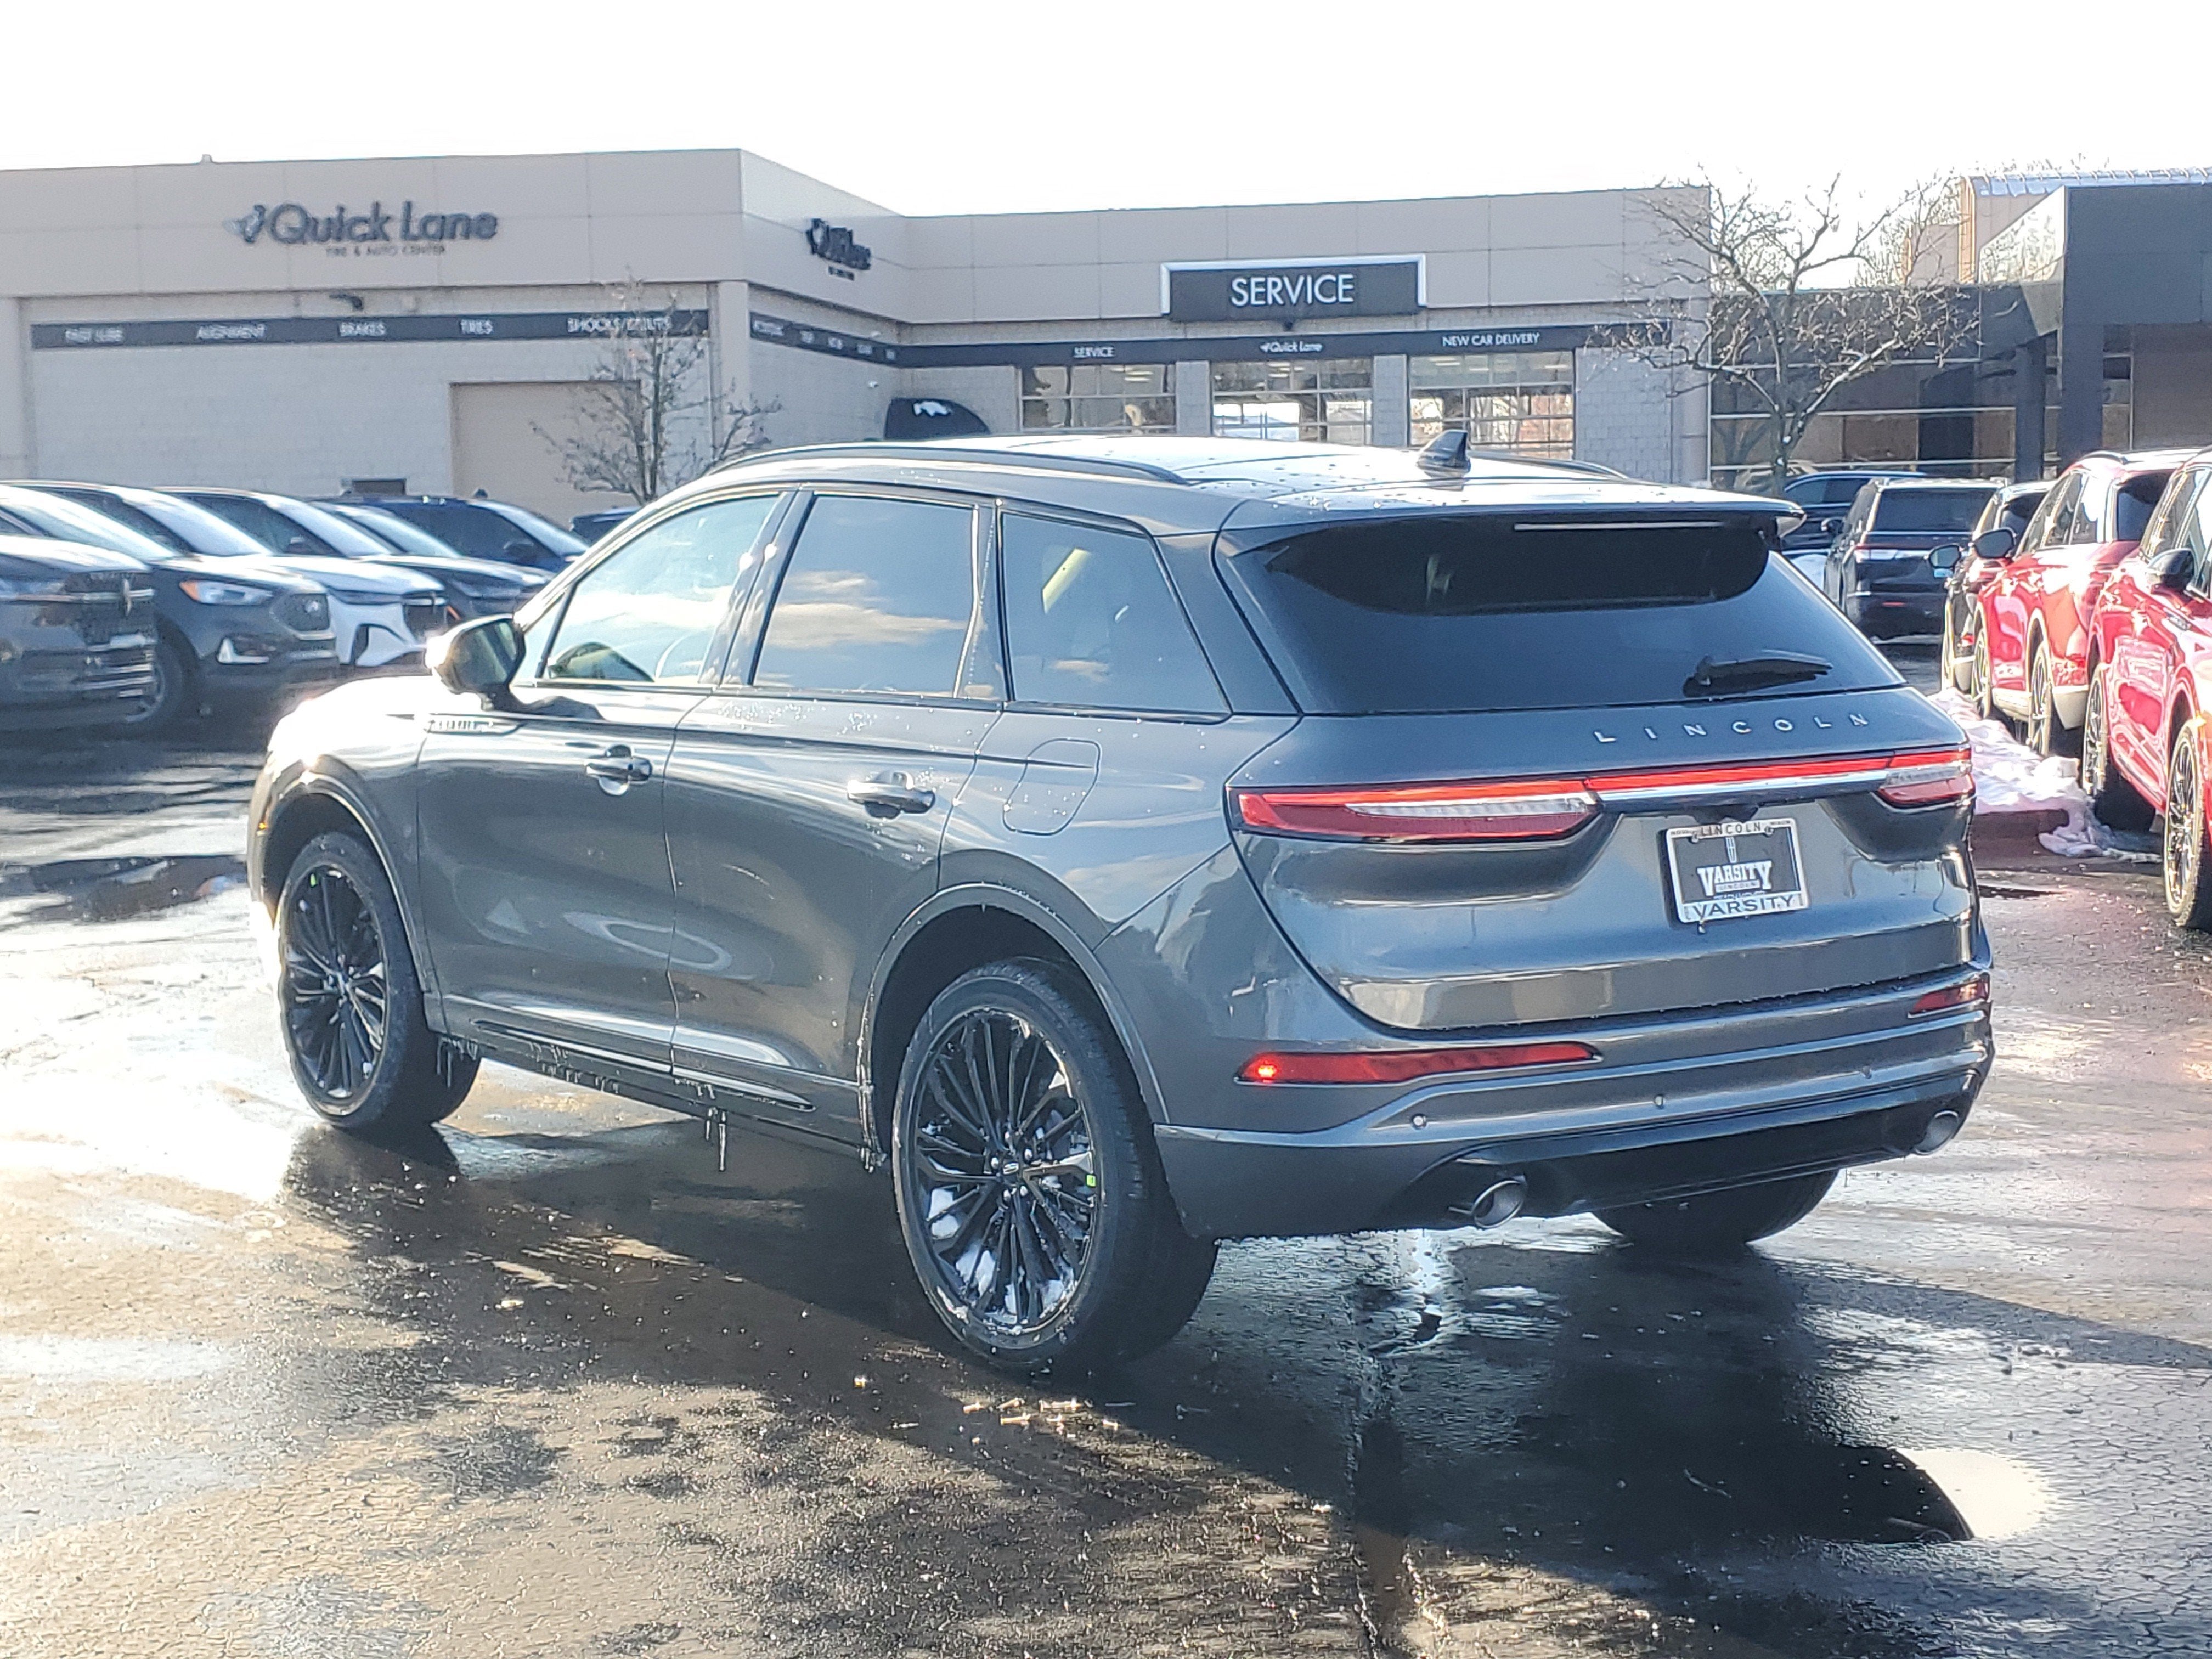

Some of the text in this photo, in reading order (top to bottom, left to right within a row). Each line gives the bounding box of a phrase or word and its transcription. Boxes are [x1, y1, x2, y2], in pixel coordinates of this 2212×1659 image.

[270, 200, 497, 244] Quick Lane
[1231, 273, 1354, 307] SERVICE
[196, 324, 266, 340] ALIGNMENT
[339, 321, 385, 337] BRAKES
[460, 319, 493, 335] TIRES
[1270, 341, 1323, 353] Quick Lane
[1442, 331, 1540, 347] NEW CAR DELIVERY
[1074, 346, 1115, 358] SERVICE
[1594, 713, 1869, 743] LINCOLN
[1701, 821, 1762, 837] LINCOLN
[1696, 860, 1773, 896] VARSITY
[1692, 895, 1793, 919] VARSITY
